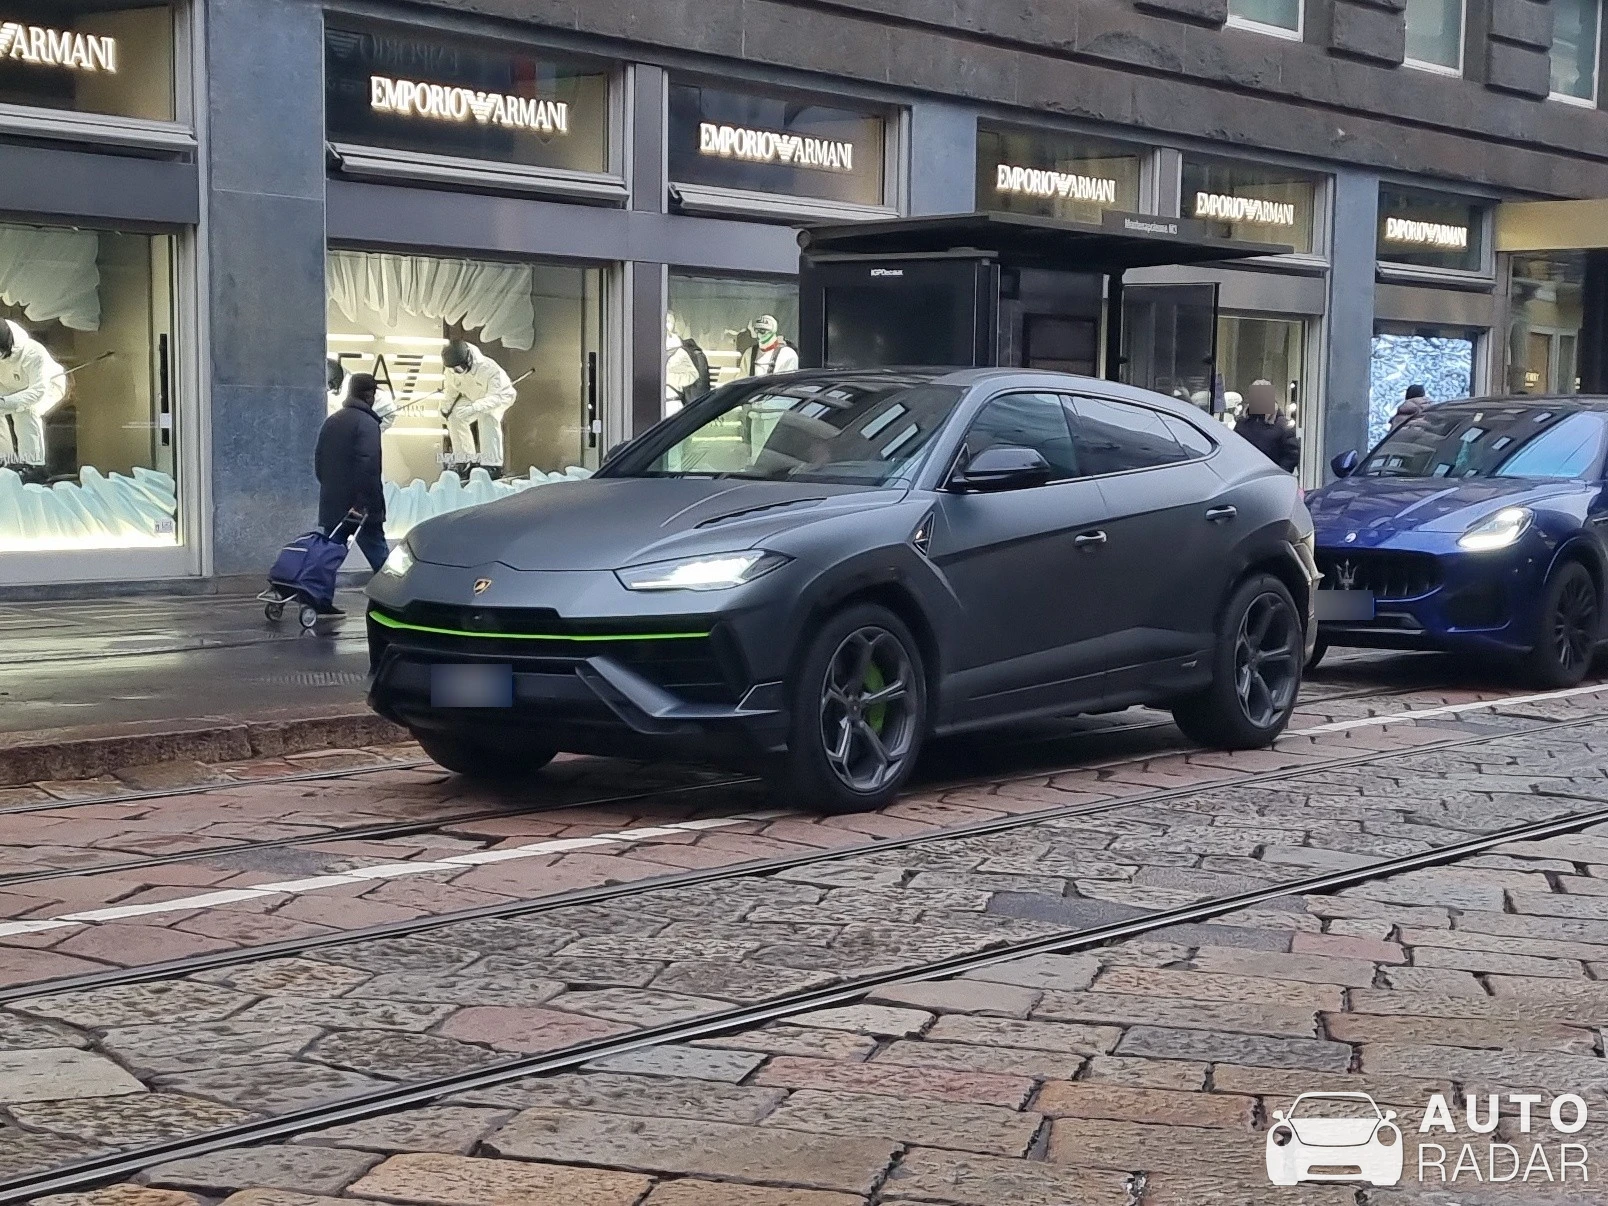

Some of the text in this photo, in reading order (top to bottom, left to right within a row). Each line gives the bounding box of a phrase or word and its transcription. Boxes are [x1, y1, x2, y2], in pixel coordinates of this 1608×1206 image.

[9, 24, 116, 74] ARMANI
[370, 75, 568, 133] EMPORIO ARMANI
[700, 122, 853, 171] EMPORIO ARMANI
[996, 164, 1116, 202] EMPORIO ARMANI
[1195, 191, 1295, 225] EMPORIO ARMANI
[1385, 217, 1468, 248] EMPORIO ARMANI
